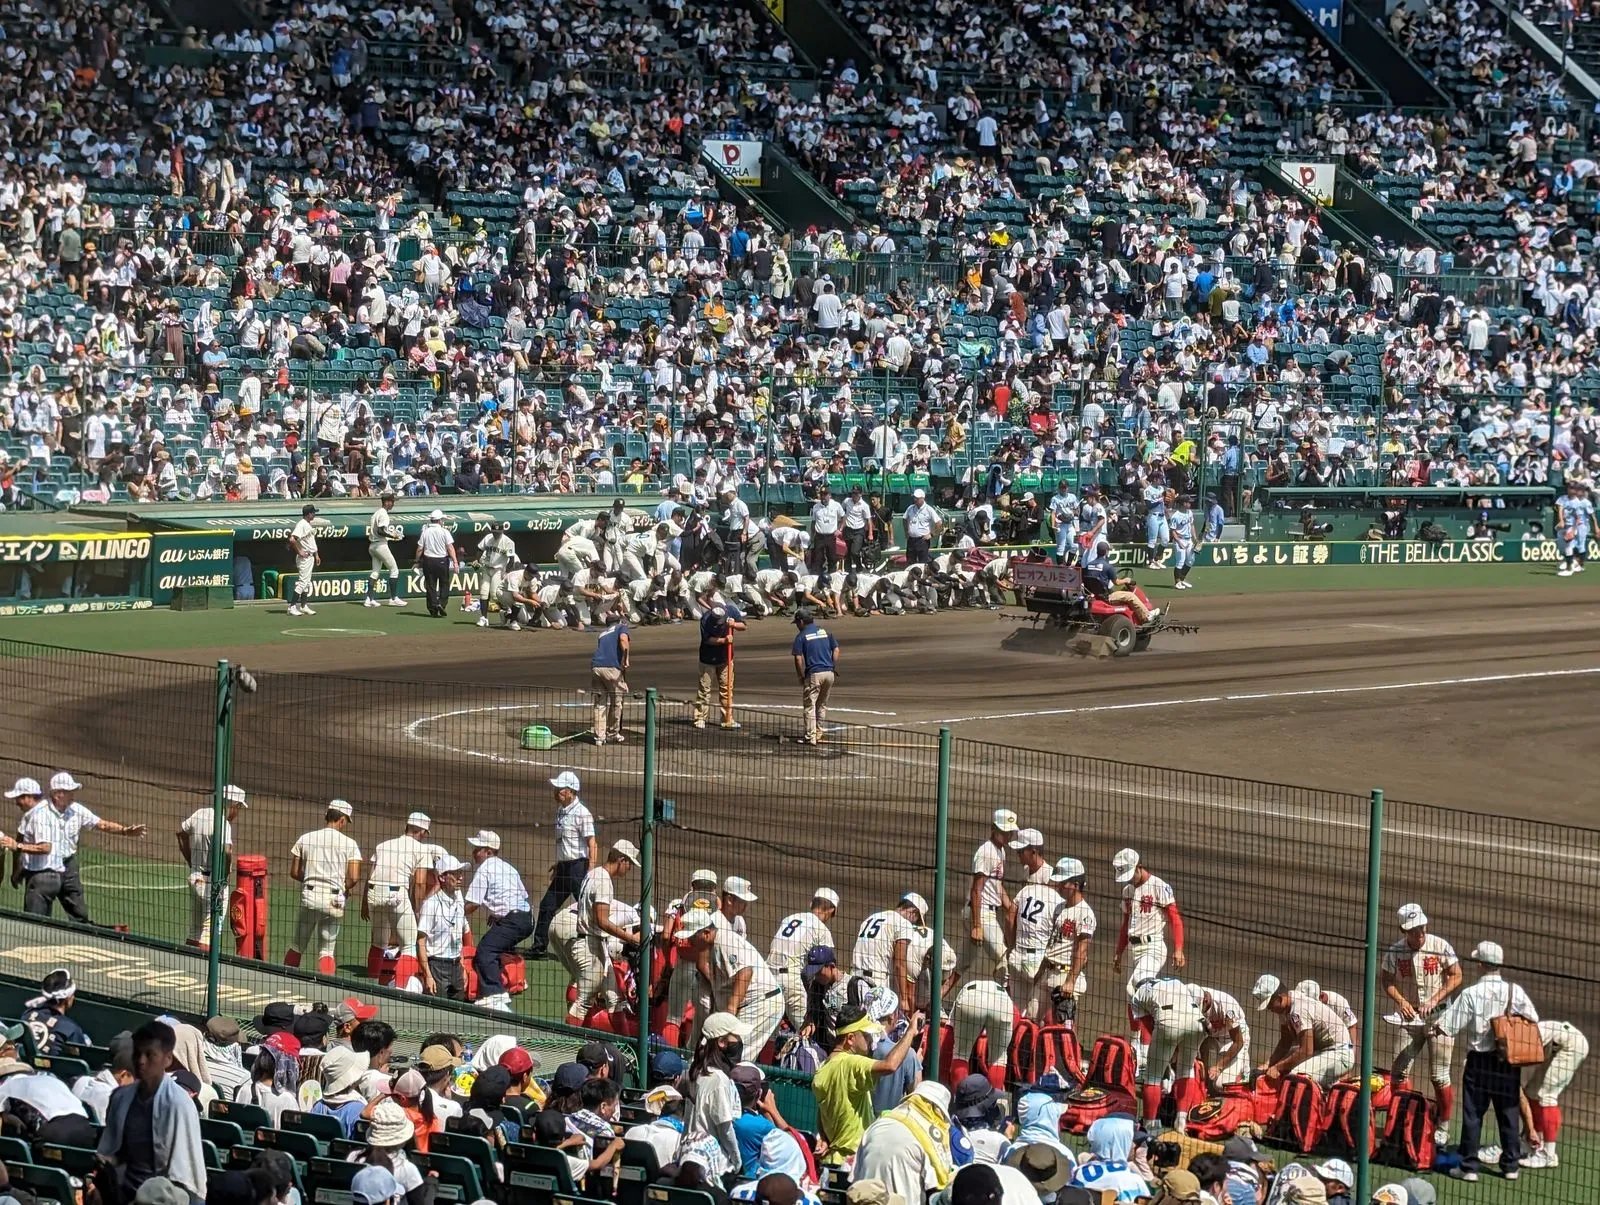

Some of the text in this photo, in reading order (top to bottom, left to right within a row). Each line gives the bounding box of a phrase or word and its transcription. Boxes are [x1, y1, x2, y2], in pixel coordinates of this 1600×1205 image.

[474, 521, 511, 532] DAO
[79, 539, 151, 561] ALINCO
[159, 548, 231, 564] au じぶん銀行
[1108, 547, 1173, 565] ウエルア
[1212, 544, 1330, 565] いちよし証券
[1368, 543, 1400, 563] THE
[159, 574, 230, 590] au じぶん銀行
[1020, 895, 1046, 925] 12
[781, 918, 803, 938] 8
[859, 917, 886, 939] 15
